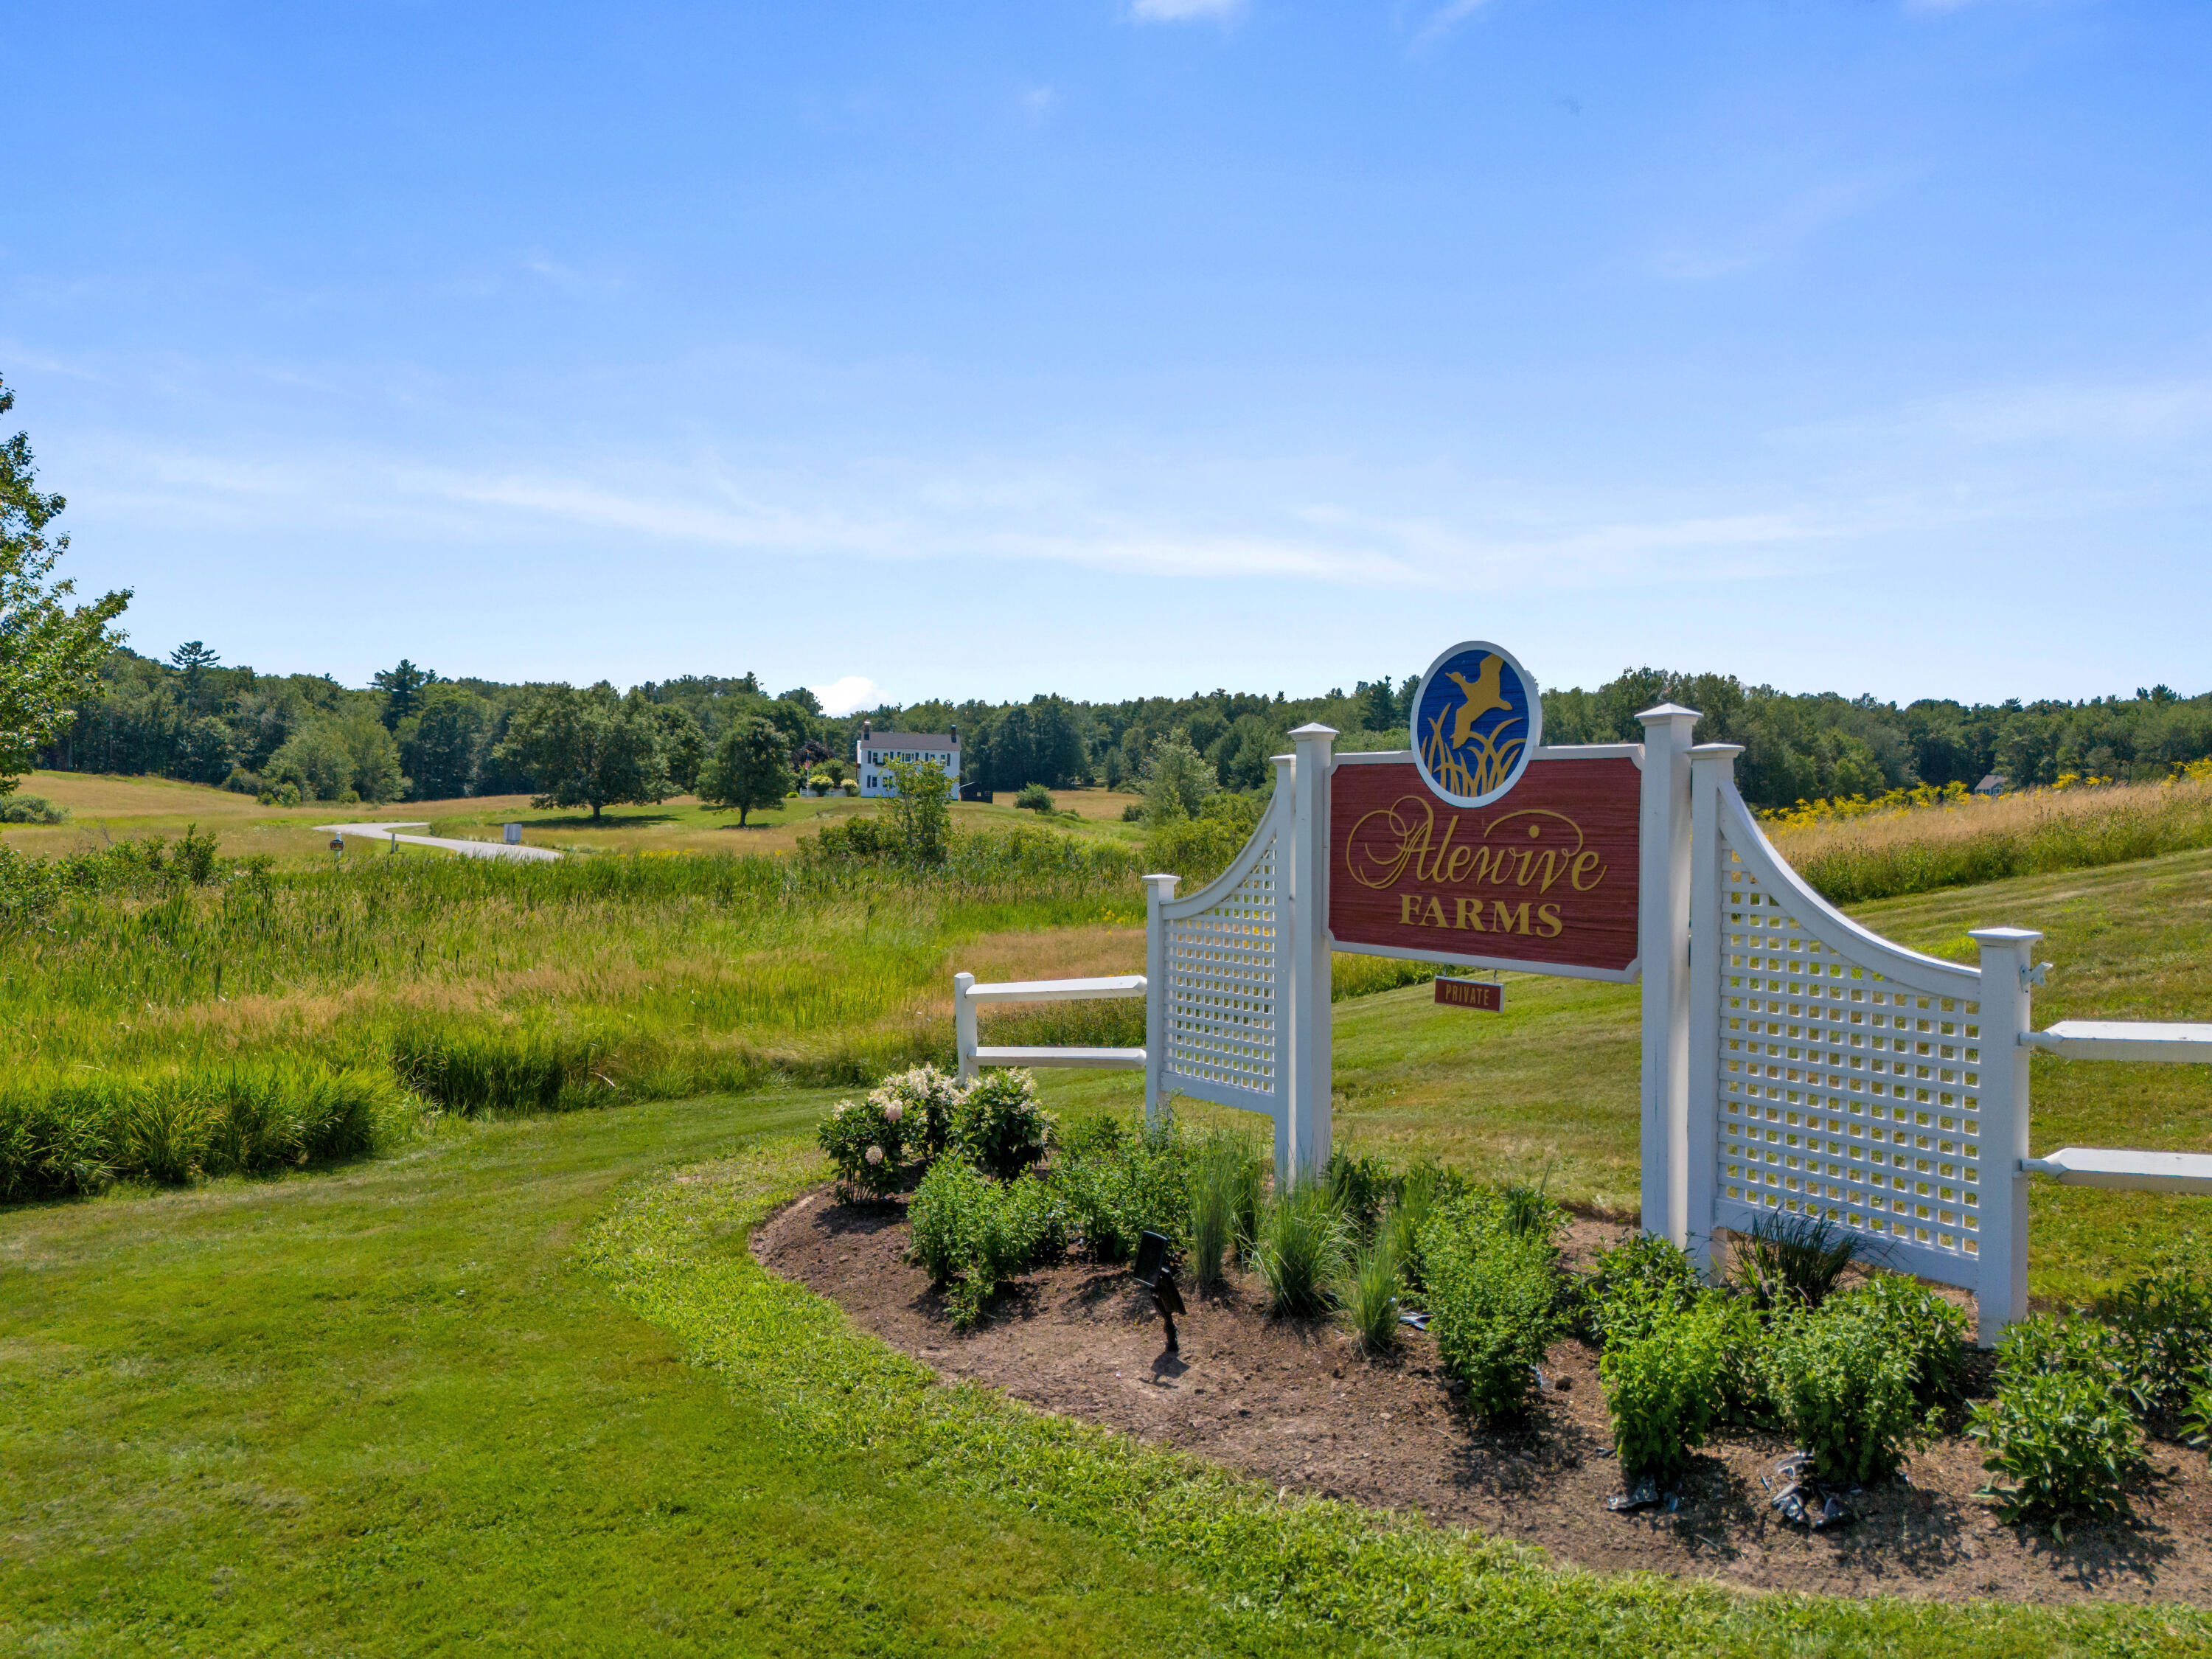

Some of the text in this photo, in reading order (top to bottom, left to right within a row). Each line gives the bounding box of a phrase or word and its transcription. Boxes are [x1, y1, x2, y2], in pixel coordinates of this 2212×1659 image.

[1346, 796, 1607, 894] Alewive
[1398, 894, 1563, 938] FARMS
[1445, 984, 1489, 1006] PRIVATE
